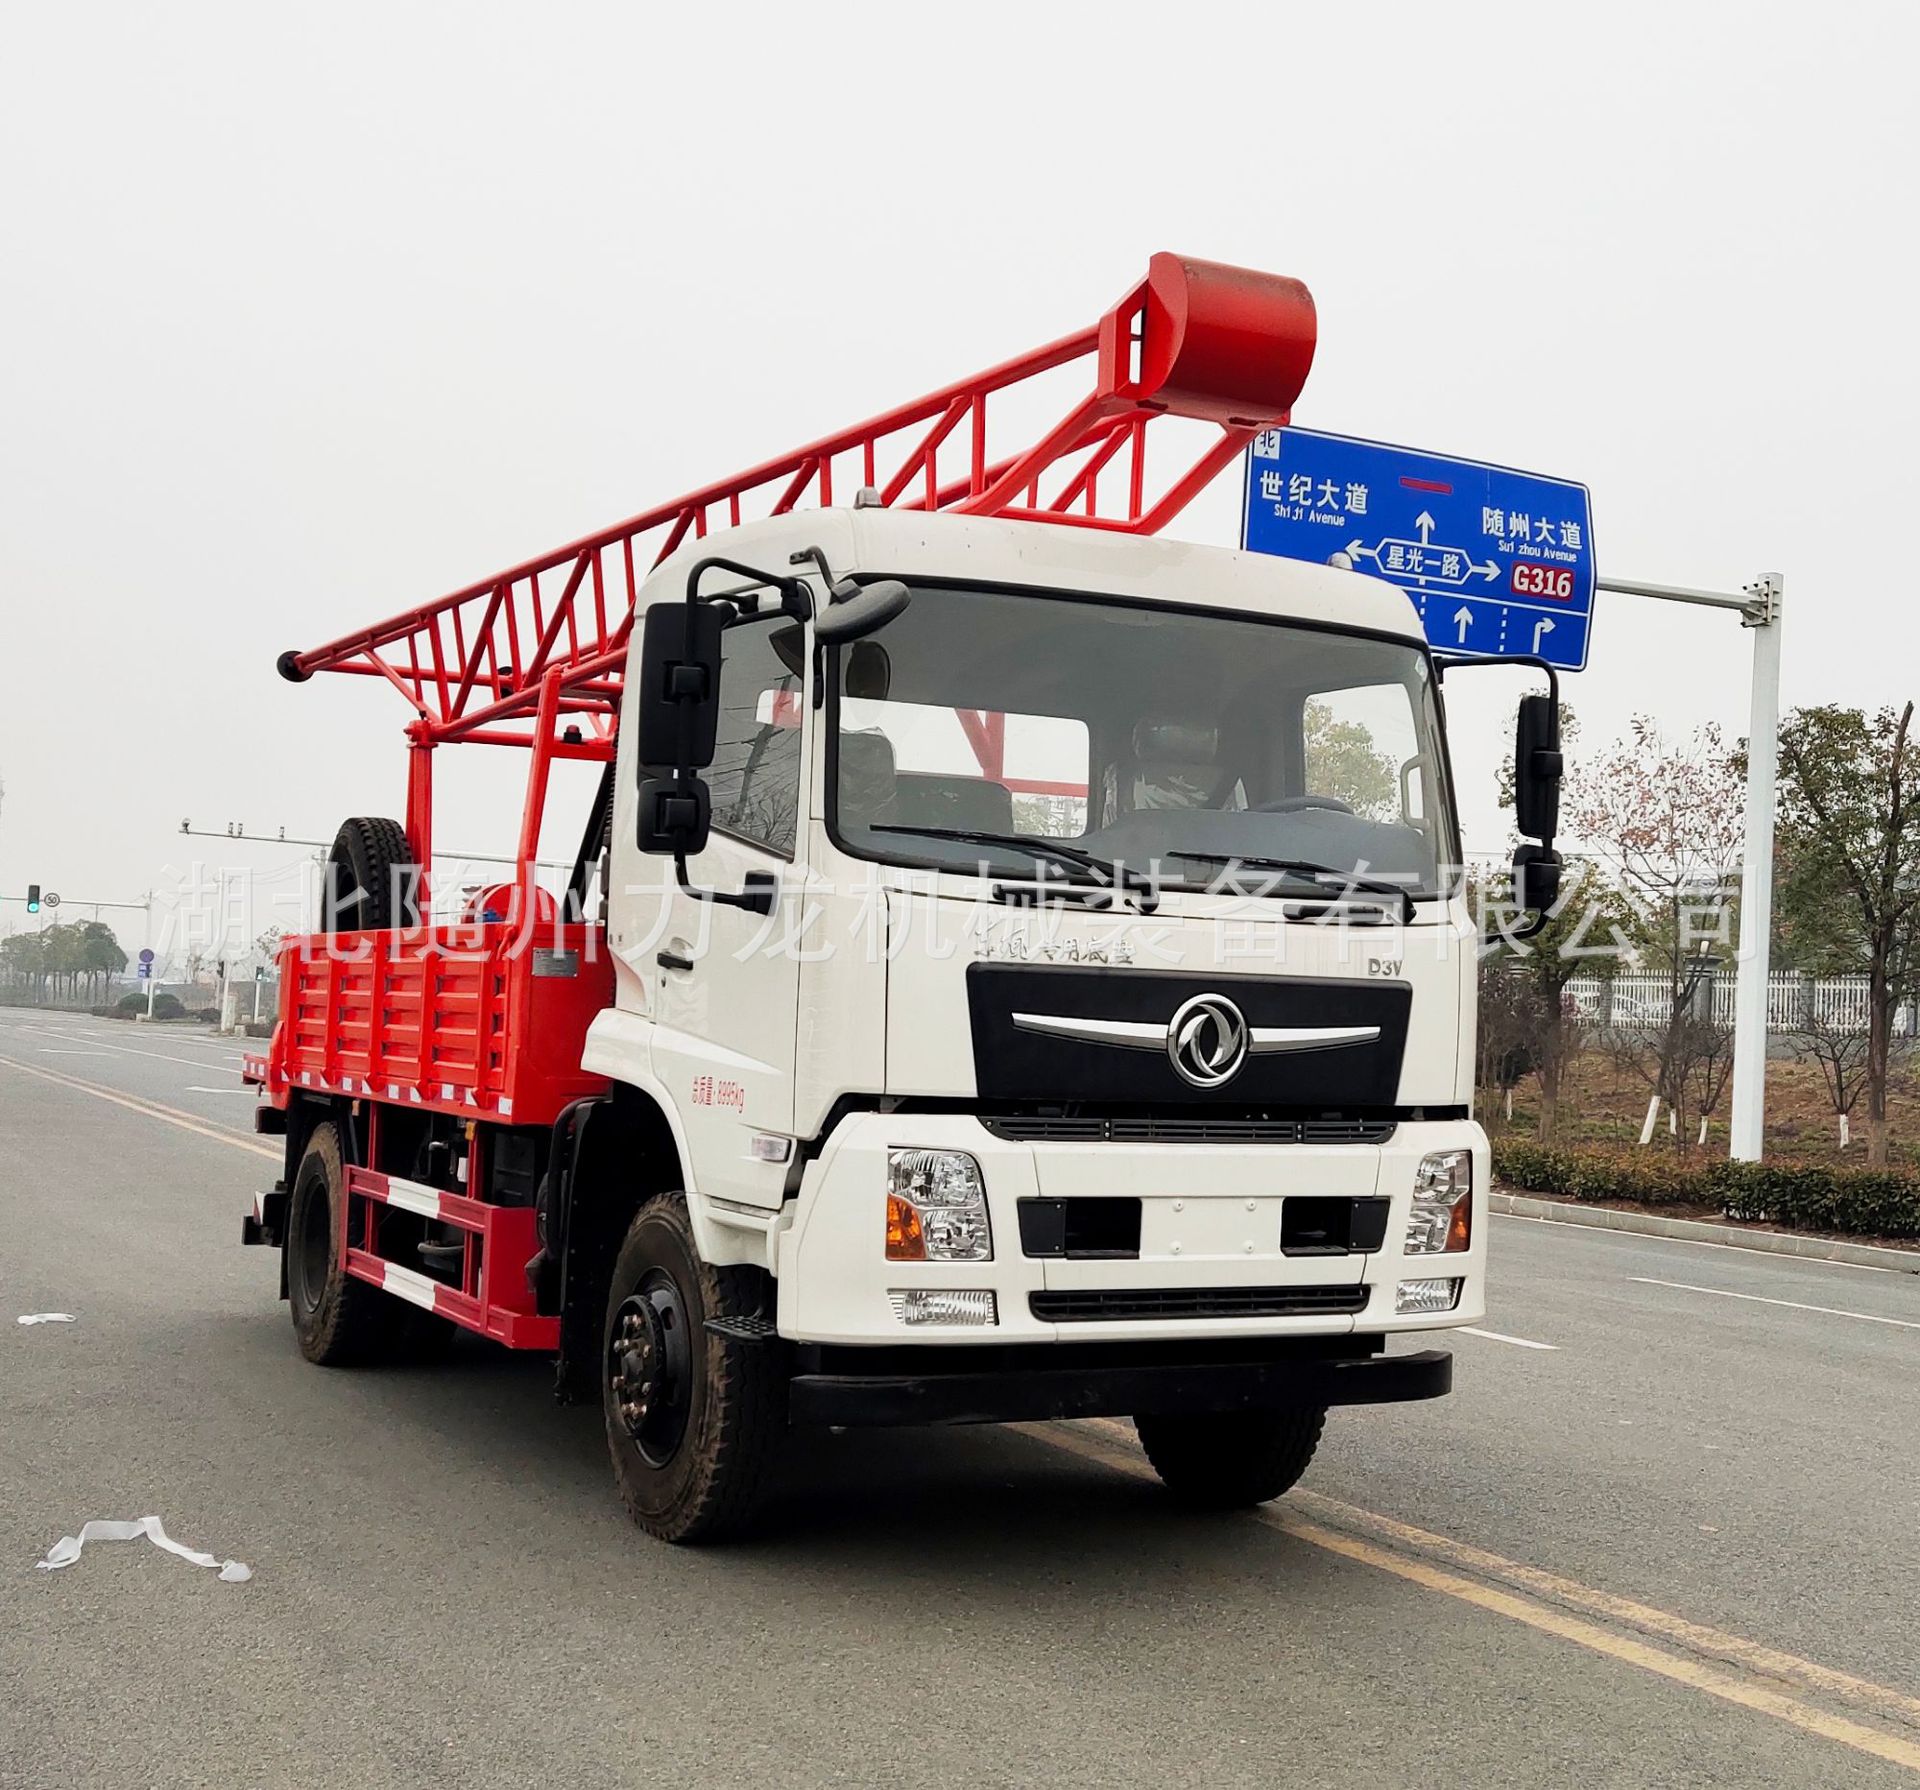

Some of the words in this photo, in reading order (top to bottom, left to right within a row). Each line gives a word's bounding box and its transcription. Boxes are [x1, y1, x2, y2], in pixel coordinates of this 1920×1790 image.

[1260, 430, 1275, 448] 北
[1260, 470, 1368, 515] 世纪大道
[1308, 509, 1345, 526] Avenue
[1482, 506, 1582, 550] 随州大道
[1386, 545, 1460, 578] 星光一路
[1518, 543, 1541, 557] zhou
[1543, 546, 1577, 563] Avenue
[1513, 565, 1571, 598] G316
[1368, 958, 1403, 976] D3V
